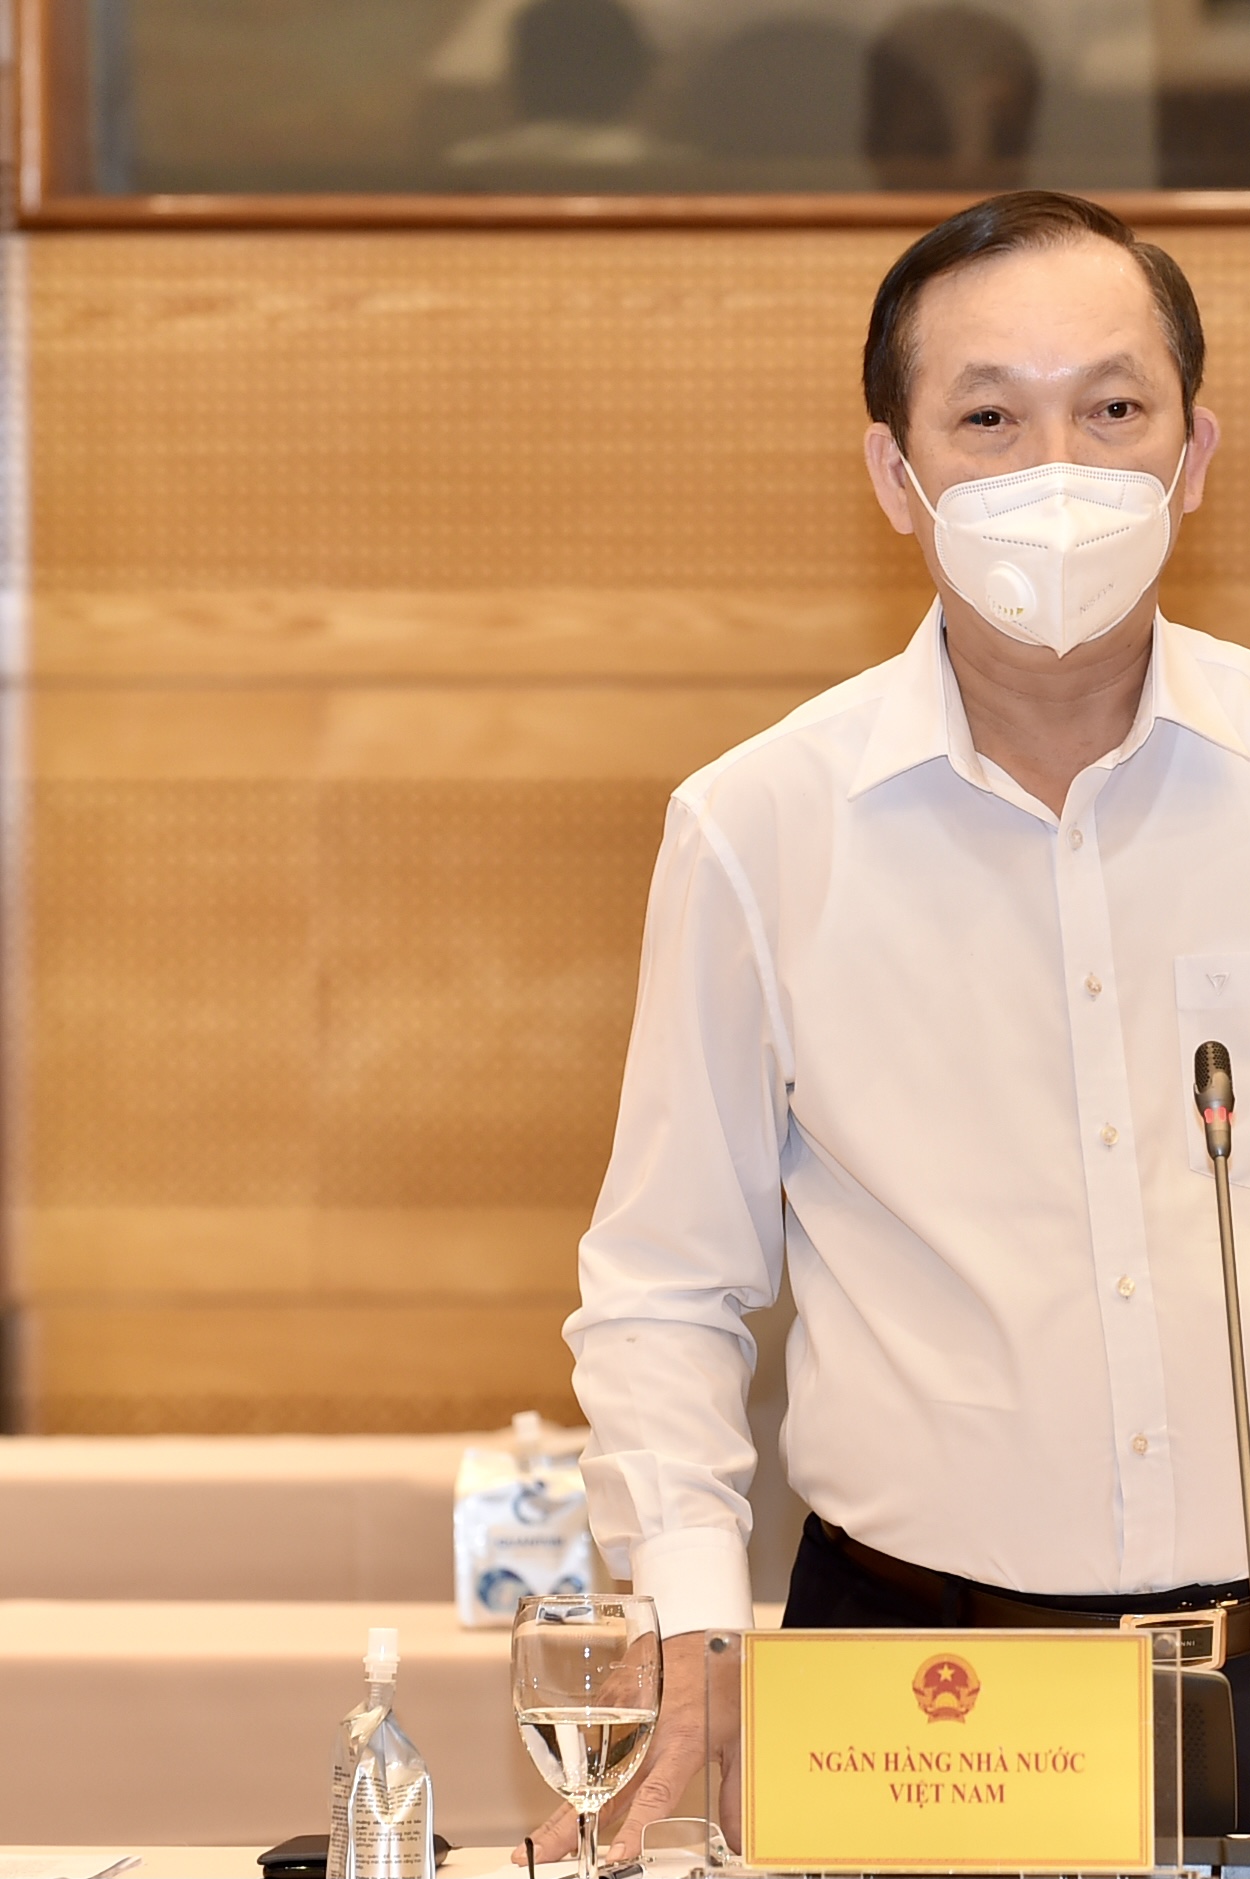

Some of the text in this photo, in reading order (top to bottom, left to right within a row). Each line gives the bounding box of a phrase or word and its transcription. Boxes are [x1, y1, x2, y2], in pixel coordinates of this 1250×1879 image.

[809, 1745, 1086, 1774] NGÂN HÀNG NHÀ NƯỚC
[889, 1780, 1006, 1809] VIỆT NAM
